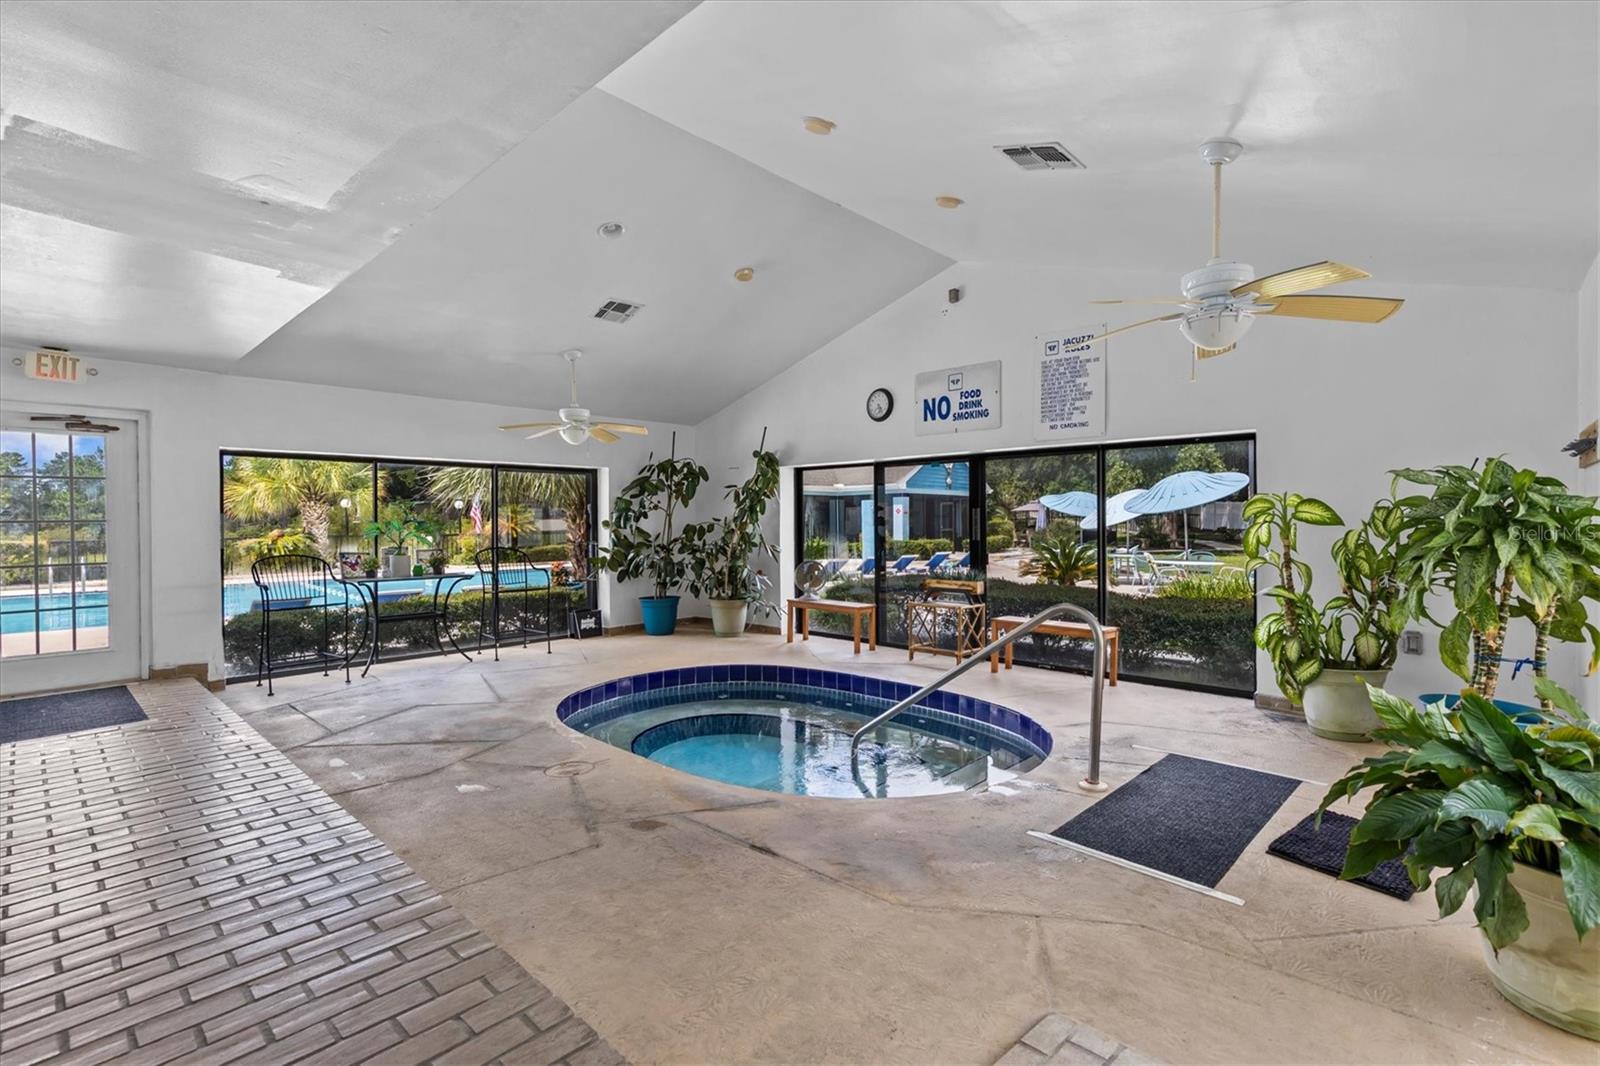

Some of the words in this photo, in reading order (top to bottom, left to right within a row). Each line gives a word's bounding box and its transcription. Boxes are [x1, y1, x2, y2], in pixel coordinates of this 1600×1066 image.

[36, 353, 80, 381] EXIT
[960, 389, 981, 400] FOOD
[923, 395, 951, 422] NO
[959, 399, 983, 410] DRINK
[953, 409, 989, 421] SMOKING
